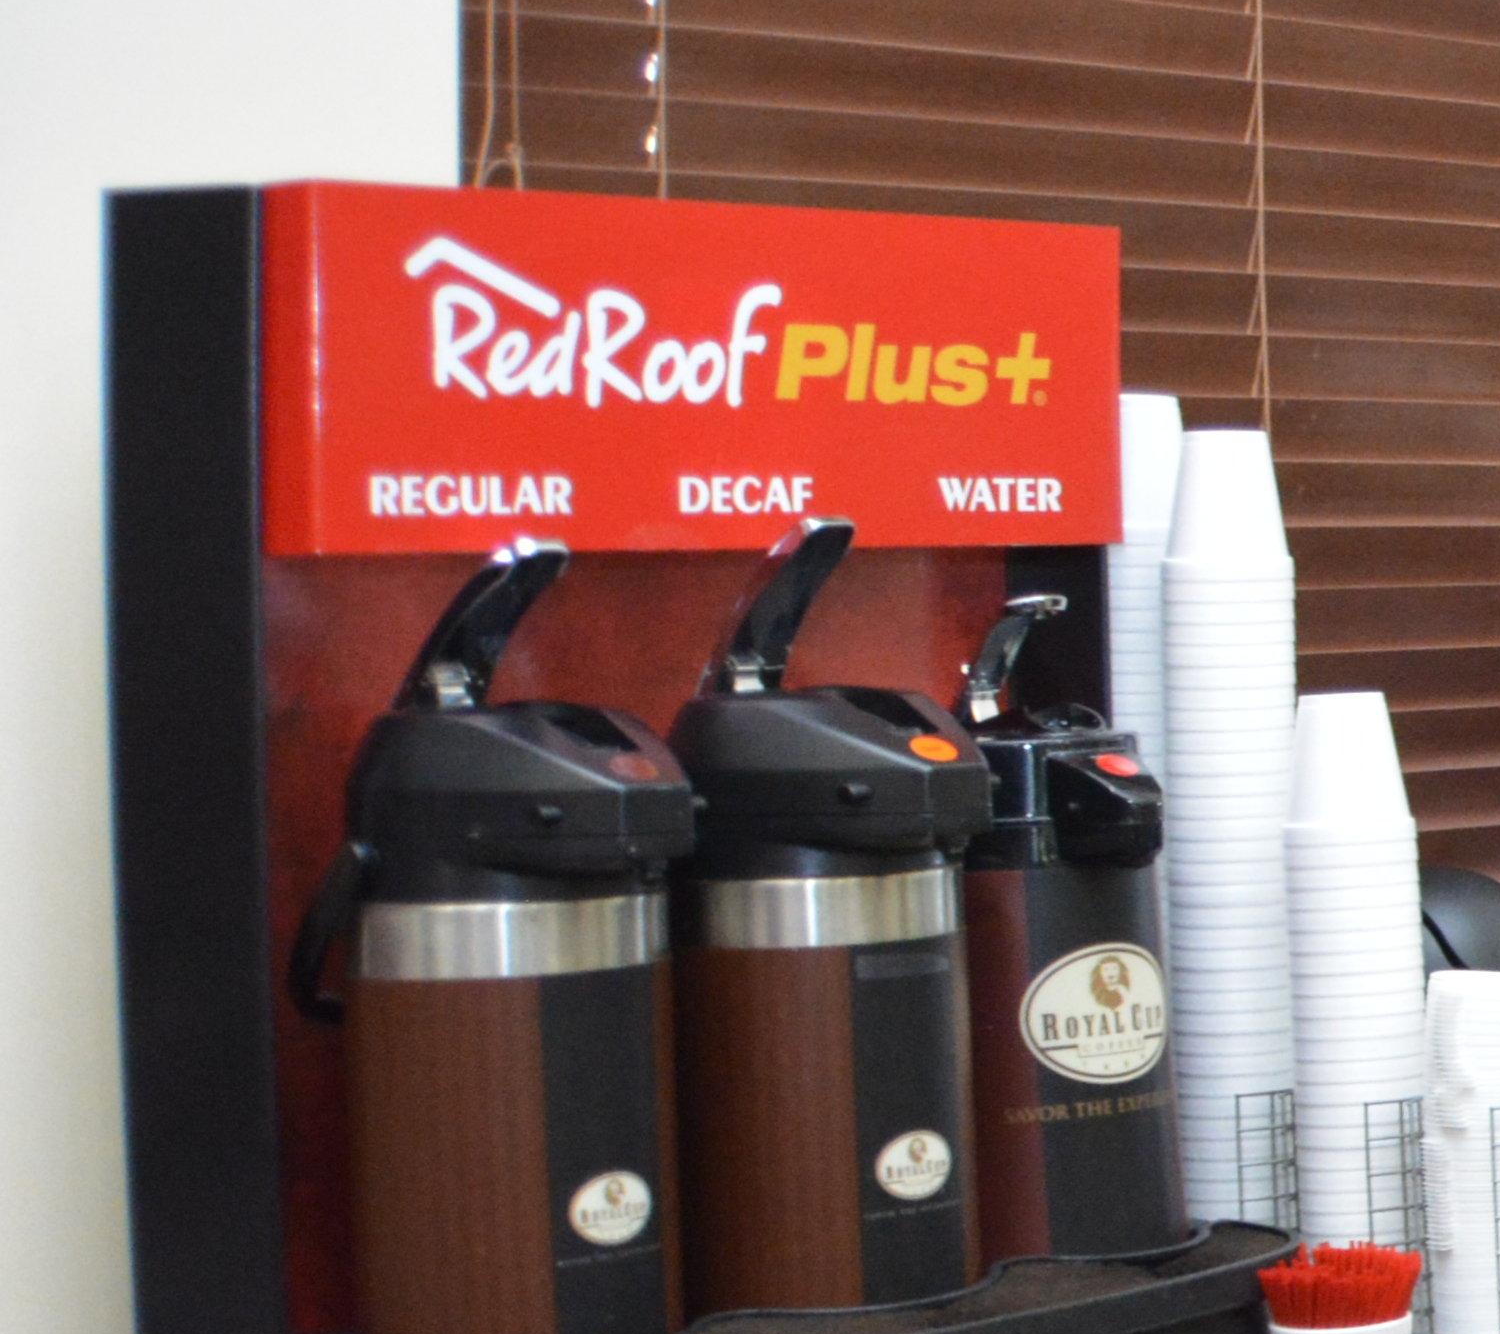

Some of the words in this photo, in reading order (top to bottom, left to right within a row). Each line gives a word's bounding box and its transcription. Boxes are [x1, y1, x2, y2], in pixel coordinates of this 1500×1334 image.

[433, 283, 782, 408] RedRoof
[369, 475, 573, 516] REGULAR
[678, 475, 814, 514] DECAF
[937, 476, 1063, 514] WATER
[1041, 1010, 1125, 1041] ROYAL
[1131, 1003, 1163, 1031] CUP
[1075, 1098, 1115, 1117] THE
